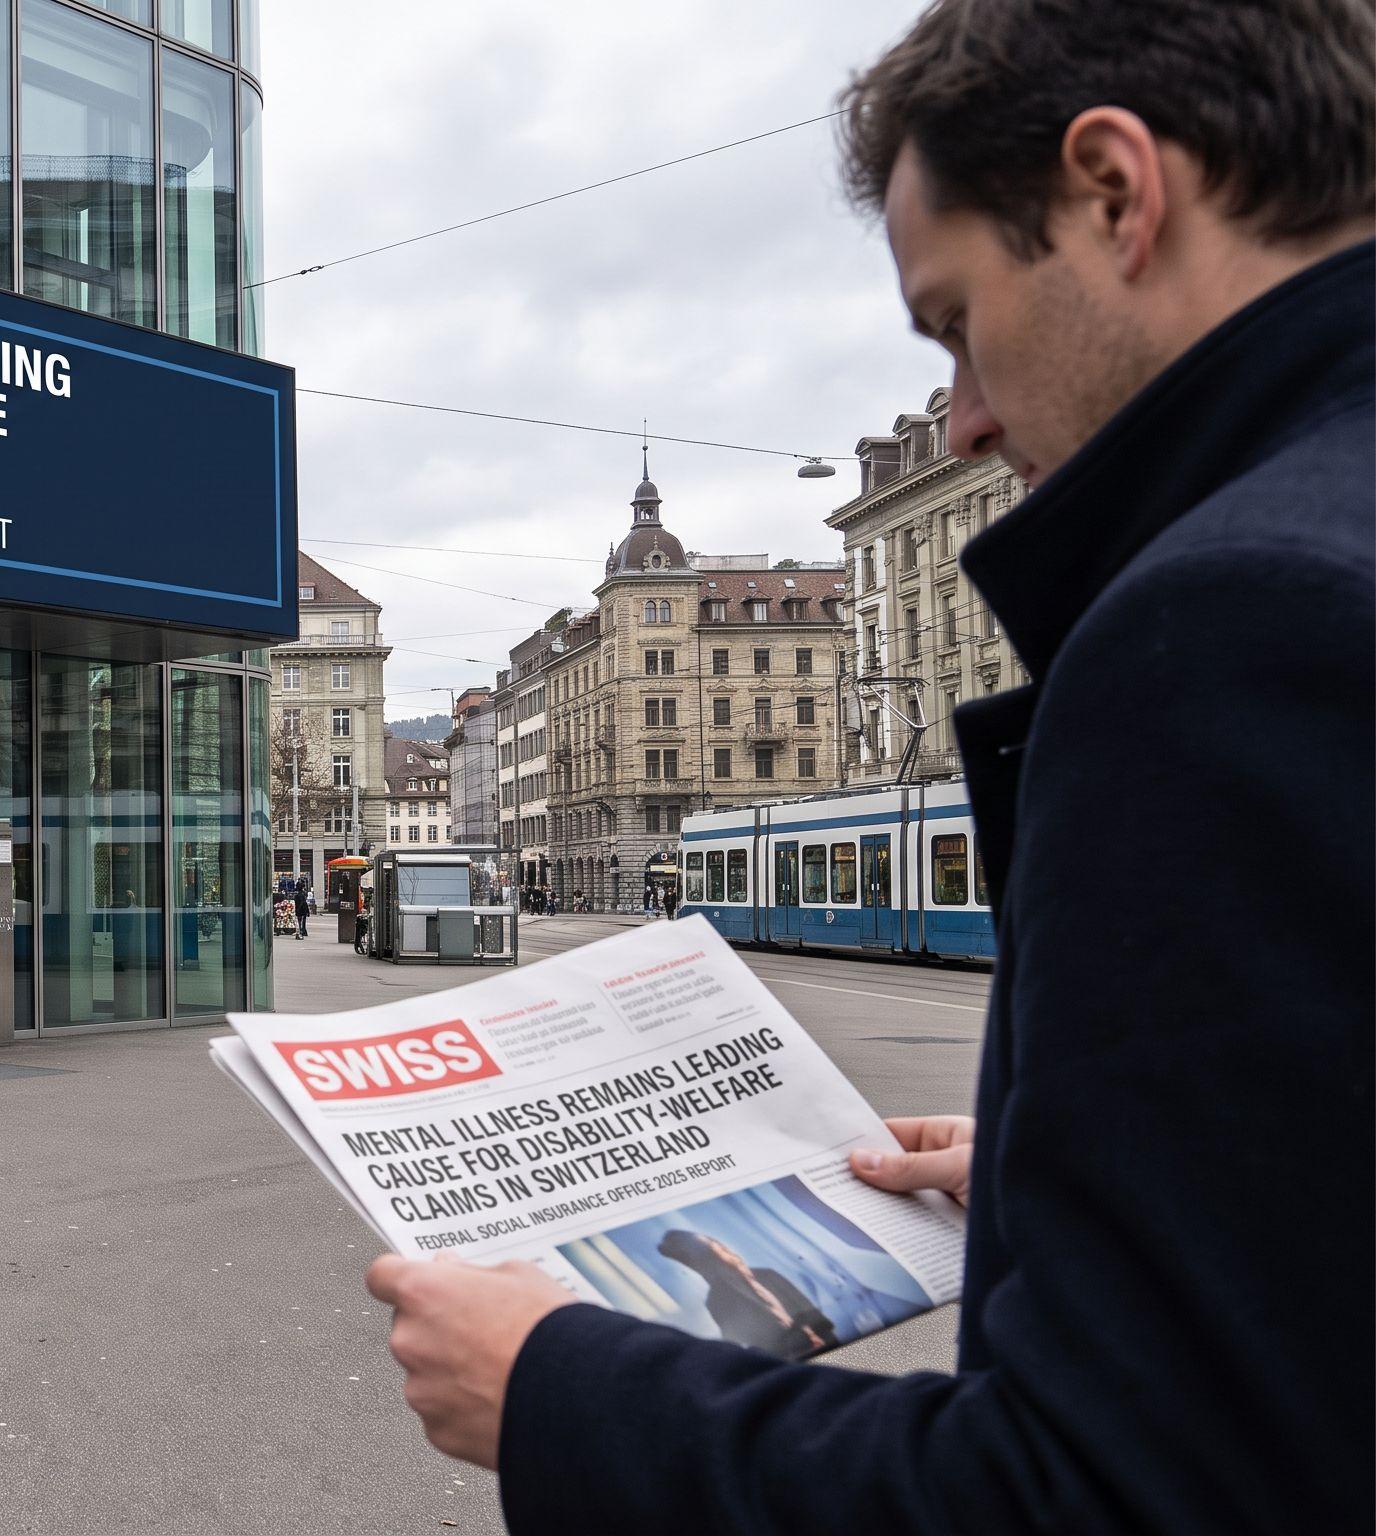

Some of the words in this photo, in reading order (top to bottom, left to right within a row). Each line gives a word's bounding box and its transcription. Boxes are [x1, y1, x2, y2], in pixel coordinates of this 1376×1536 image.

[293, 1030, 483, 1093] SWISS
[342, 1123, 456, 1157] MENTAL
[450, 1099, 561, 1143] ILLNESS
[556, 1065, 675, 1117] REMAINS
[671, 1027, 784, 1083] LEADING
[367, 1154, 462, 1190] CAUSE
[458, 1143, 521, 1176] FOR
[515, 1062, 784, 1162] DISABILITY-WELFARE
[390, 1184, 498, 1222] CLAIMS
[495, 1174, 533, 1203] IN
[530, 1125, 711, 1193] SWITZERLAND
[414, 1229, 478, 1250] FEDERAL
[477, 1216, 529, 1239] SOCIAL
[528, 1193, 609, 1225] INSURANCE
[607, 1179, 656, 1202] OFFICE
[653, 1169, 688, 1189] 2025
[685, 1154, 737, 1180] REPORT
